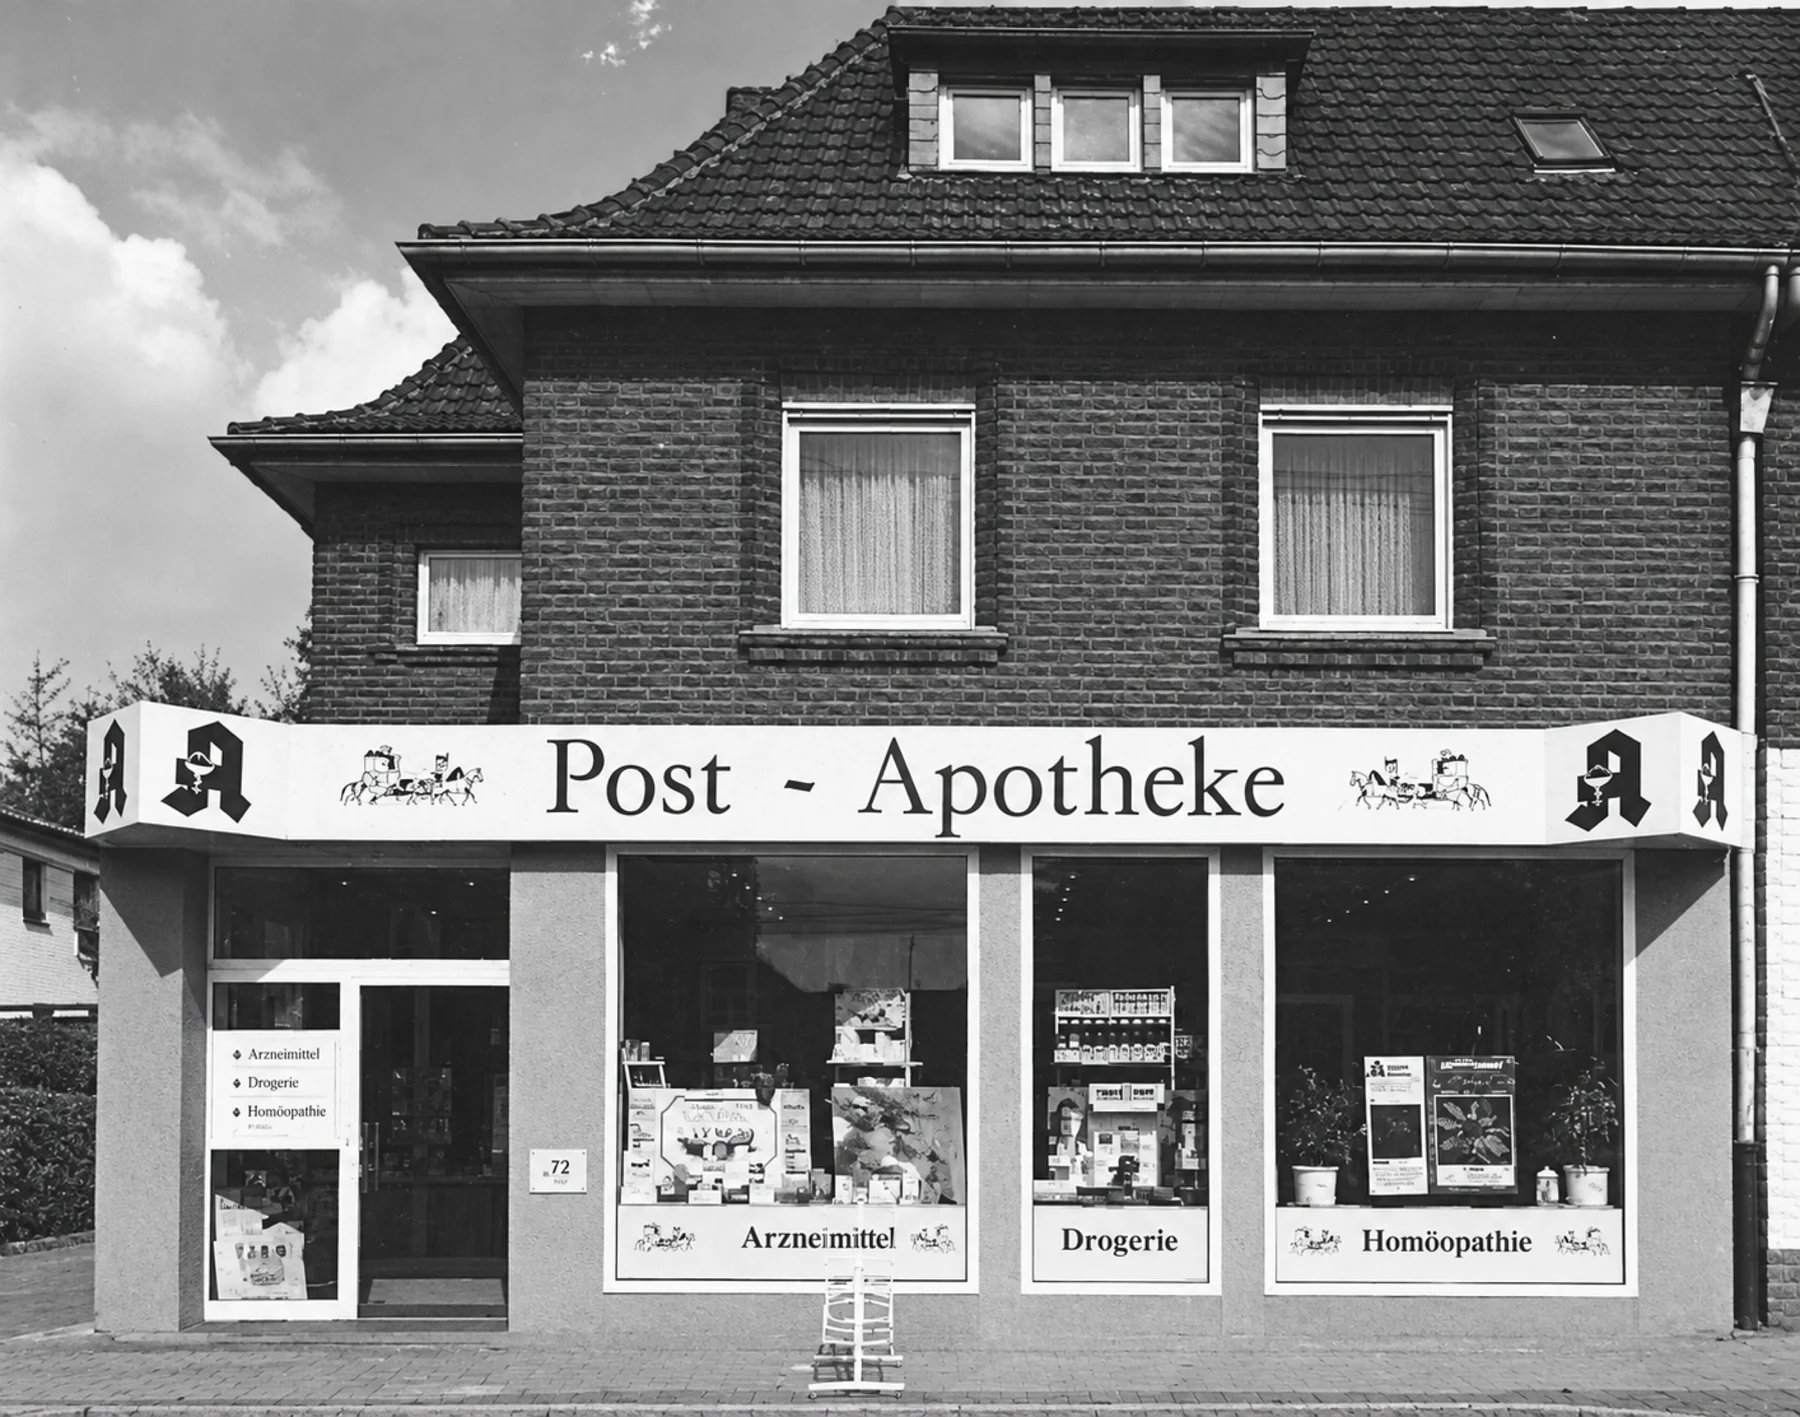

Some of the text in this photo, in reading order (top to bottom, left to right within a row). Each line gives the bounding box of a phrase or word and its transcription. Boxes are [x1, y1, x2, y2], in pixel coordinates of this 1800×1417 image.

[546, 739, 731, 816] Post
[857, 734, 1285, 838] Apotheke
[248, 1048, 320, 1060] Arzneimittel
[248, 1076, 299, 1091] Drogerie
[248, 1104, 327, 1120] Homöopathie
[551, 1159, 570, 1175] 72
[742, 1226, 895, 1250] Arzneimittel
[1061, 1228, 1178, 1258] Drogerie
[1362, 1229, 1532, 1259] Homöopathie
